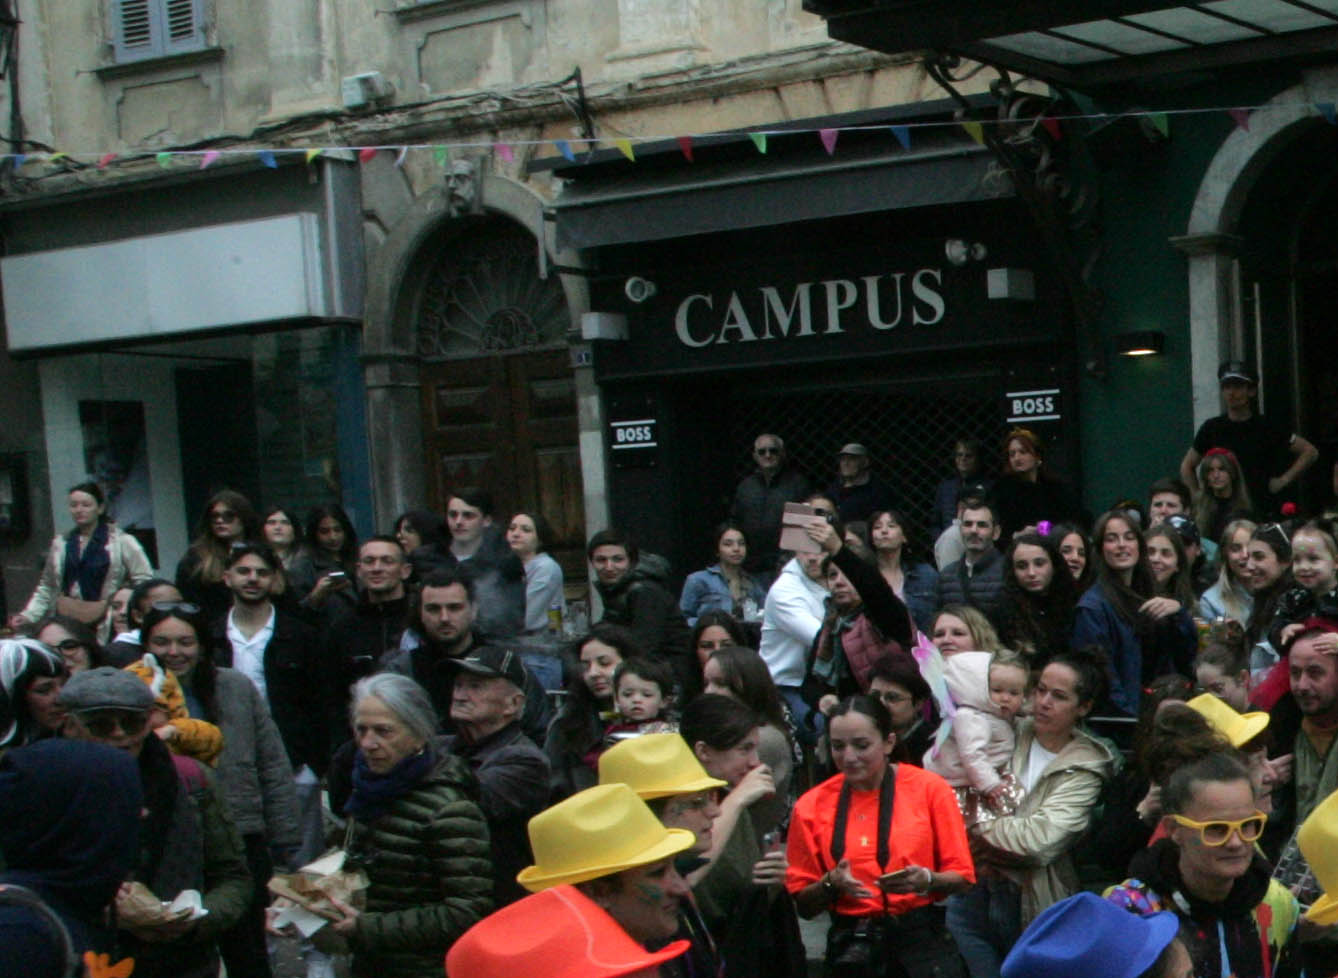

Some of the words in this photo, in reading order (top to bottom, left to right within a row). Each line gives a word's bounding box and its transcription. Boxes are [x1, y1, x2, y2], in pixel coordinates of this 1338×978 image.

[675, 269, 945, 347] CAMPUS
[1012, 397, 1055, 415] BOSS
[616, 426, 652, 442] BOSS
